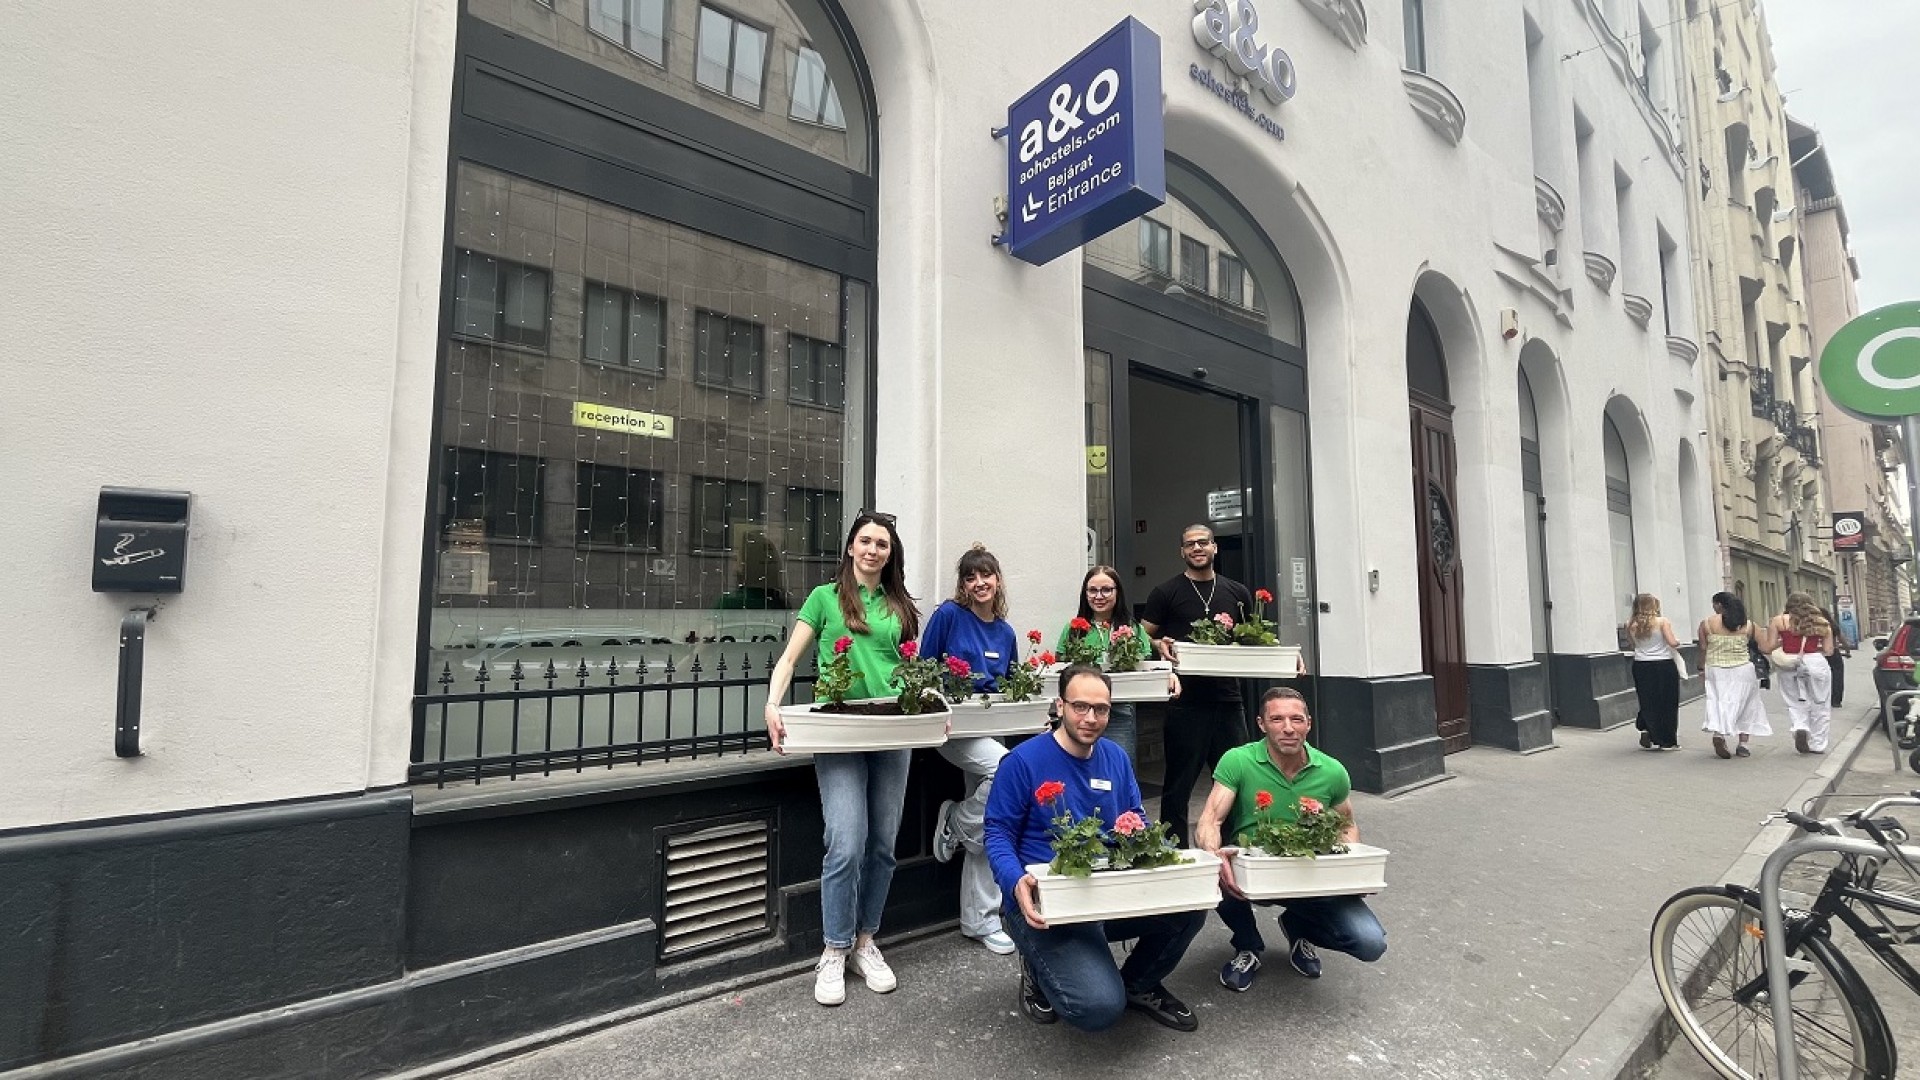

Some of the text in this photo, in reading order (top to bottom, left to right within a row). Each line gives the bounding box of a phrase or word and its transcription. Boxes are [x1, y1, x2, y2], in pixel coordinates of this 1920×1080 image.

[1194, 0, 1296, 102] a&o
[1019, 68, 1119, 163] a&o
[1020, 111, 1120, 185] aohostels.com
[1048, 153, 1094, 191] Bejárat
[1048, 160, 1122, 214] Entrance
[581, 410, 646, 429] reception
